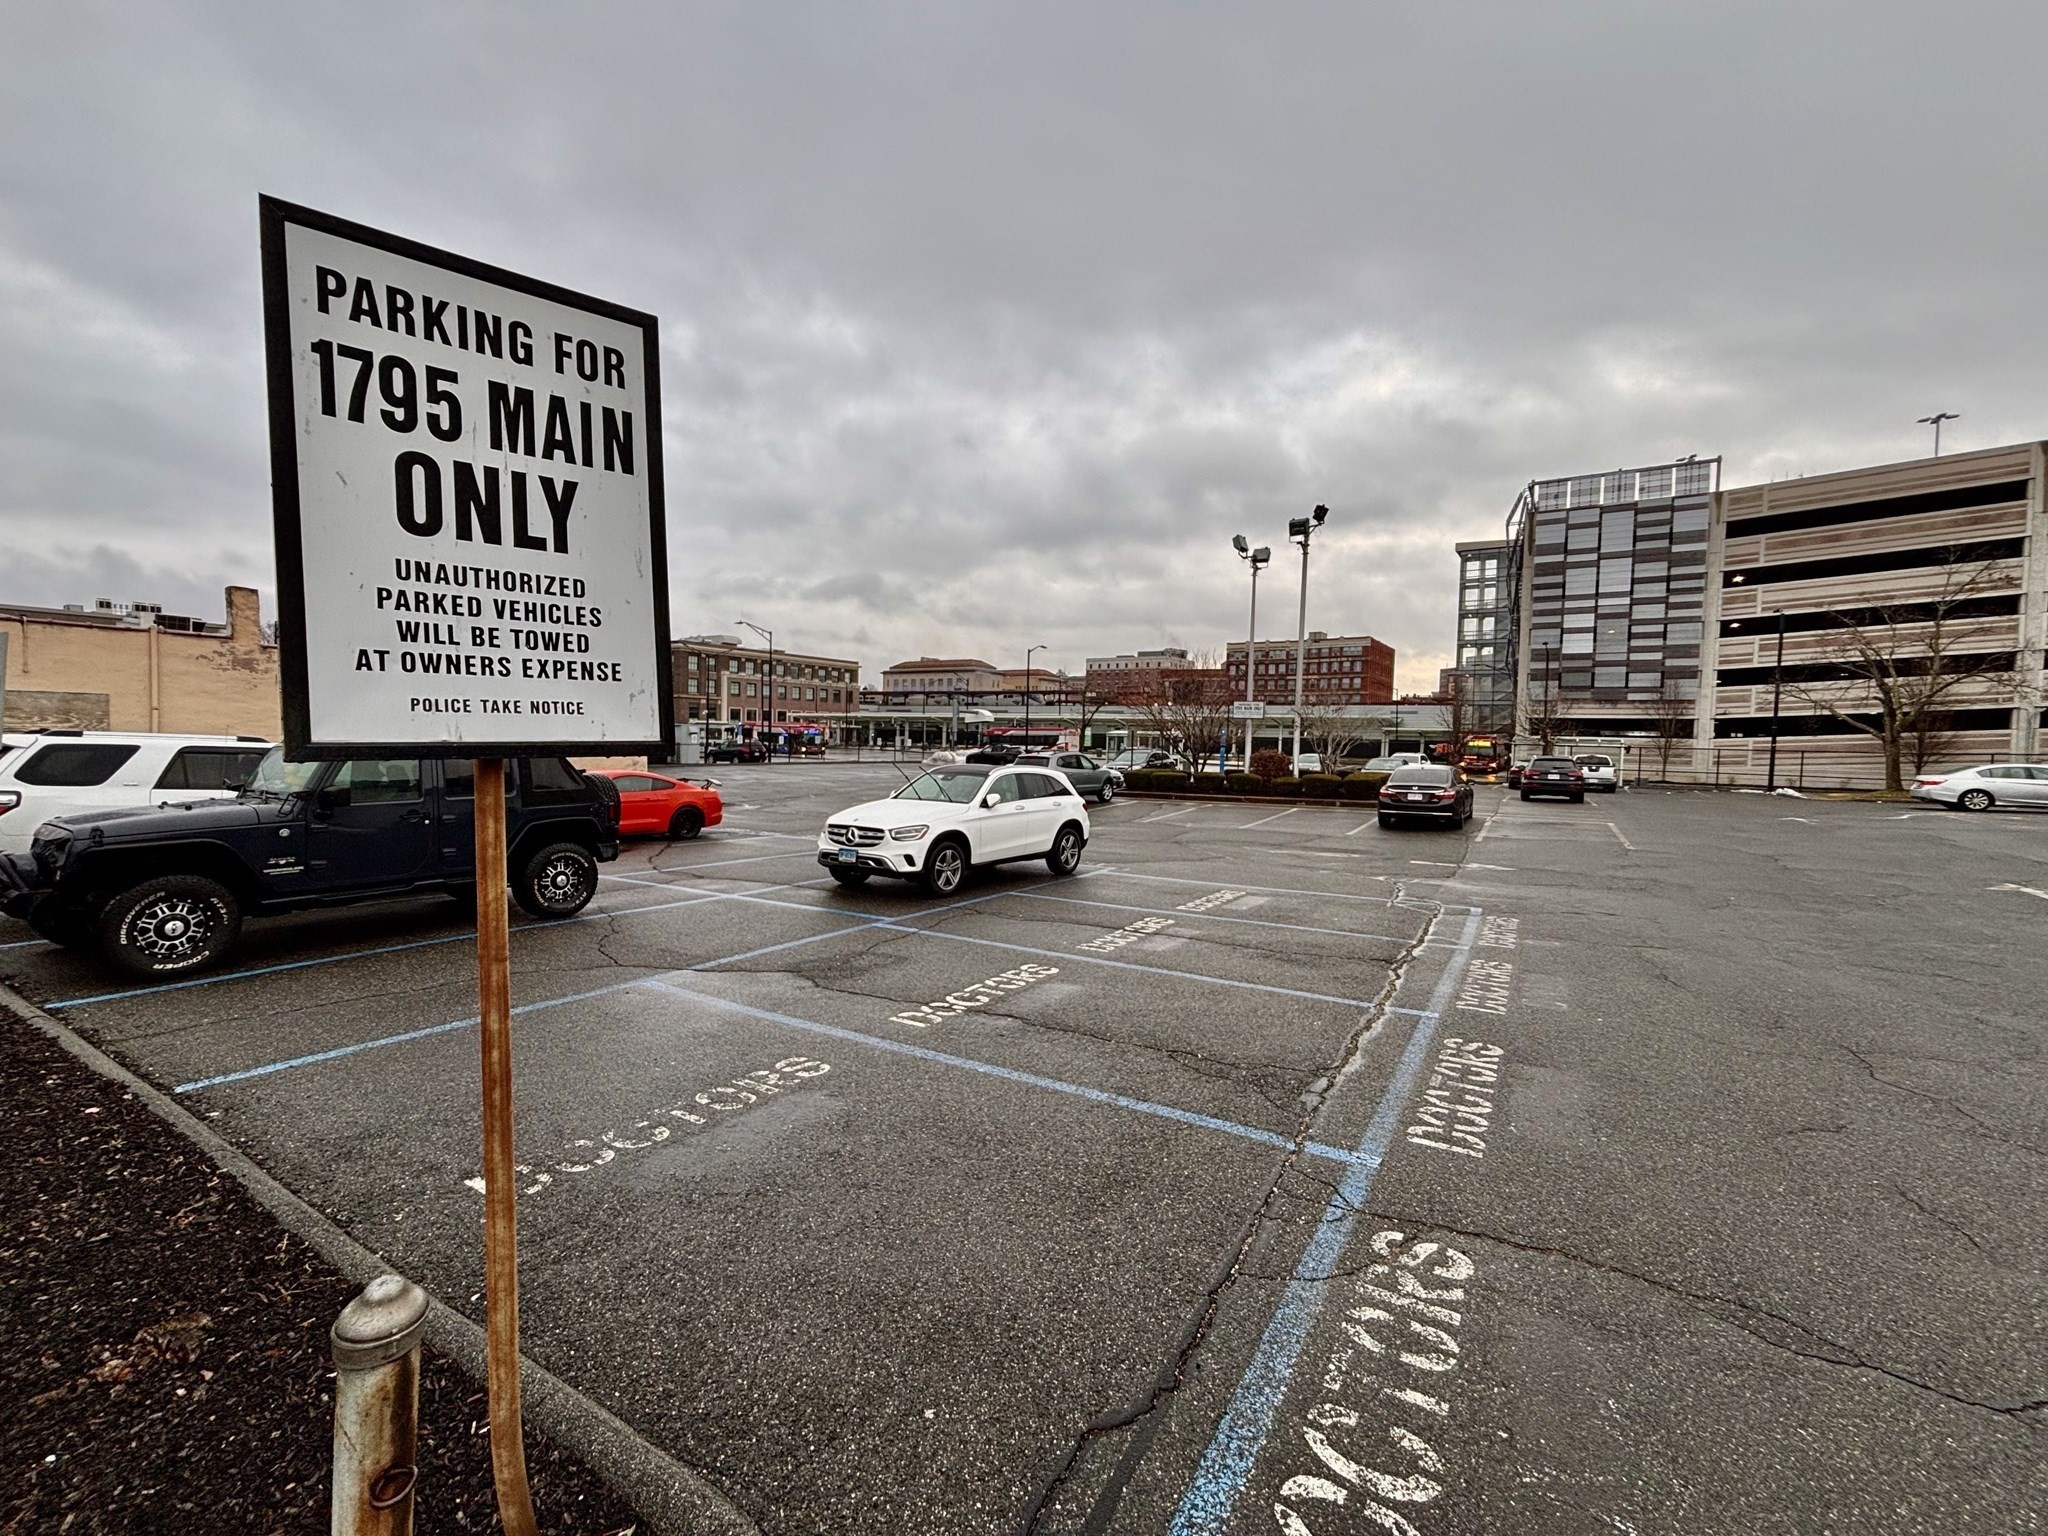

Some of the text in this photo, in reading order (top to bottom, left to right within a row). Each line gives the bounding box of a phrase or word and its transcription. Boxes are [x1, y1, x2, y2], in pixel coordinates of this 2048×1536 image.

[315, 264, 626, 390] PARKING FOR
[310, 338, 635, 476] 1795 MAIN
[394, 450, 579, 555] ONLY
[395, 558, 586, 599] UNAUTHORIZED
[376, 586, 602, 628] PARKED VEHICLES
[395, 619, 590, 654] WILL BE TOWED
[354, 648, 622, 682] AT OWNERS EXPENSE
[410, 697, 585, 715] POLICE TAKE NOTICE
[120, 891, 166, 945] DISCOVERER
[1077, 916, 1175, 953] DOCTORS
[152, 950, 211, 970] COOPER
[889, 963, 1060, 1028] DOCTORS
[1406, 1038, 1505, 1159] DOCTORS
[1273, 1231, 1476, 1536] OCTORS
